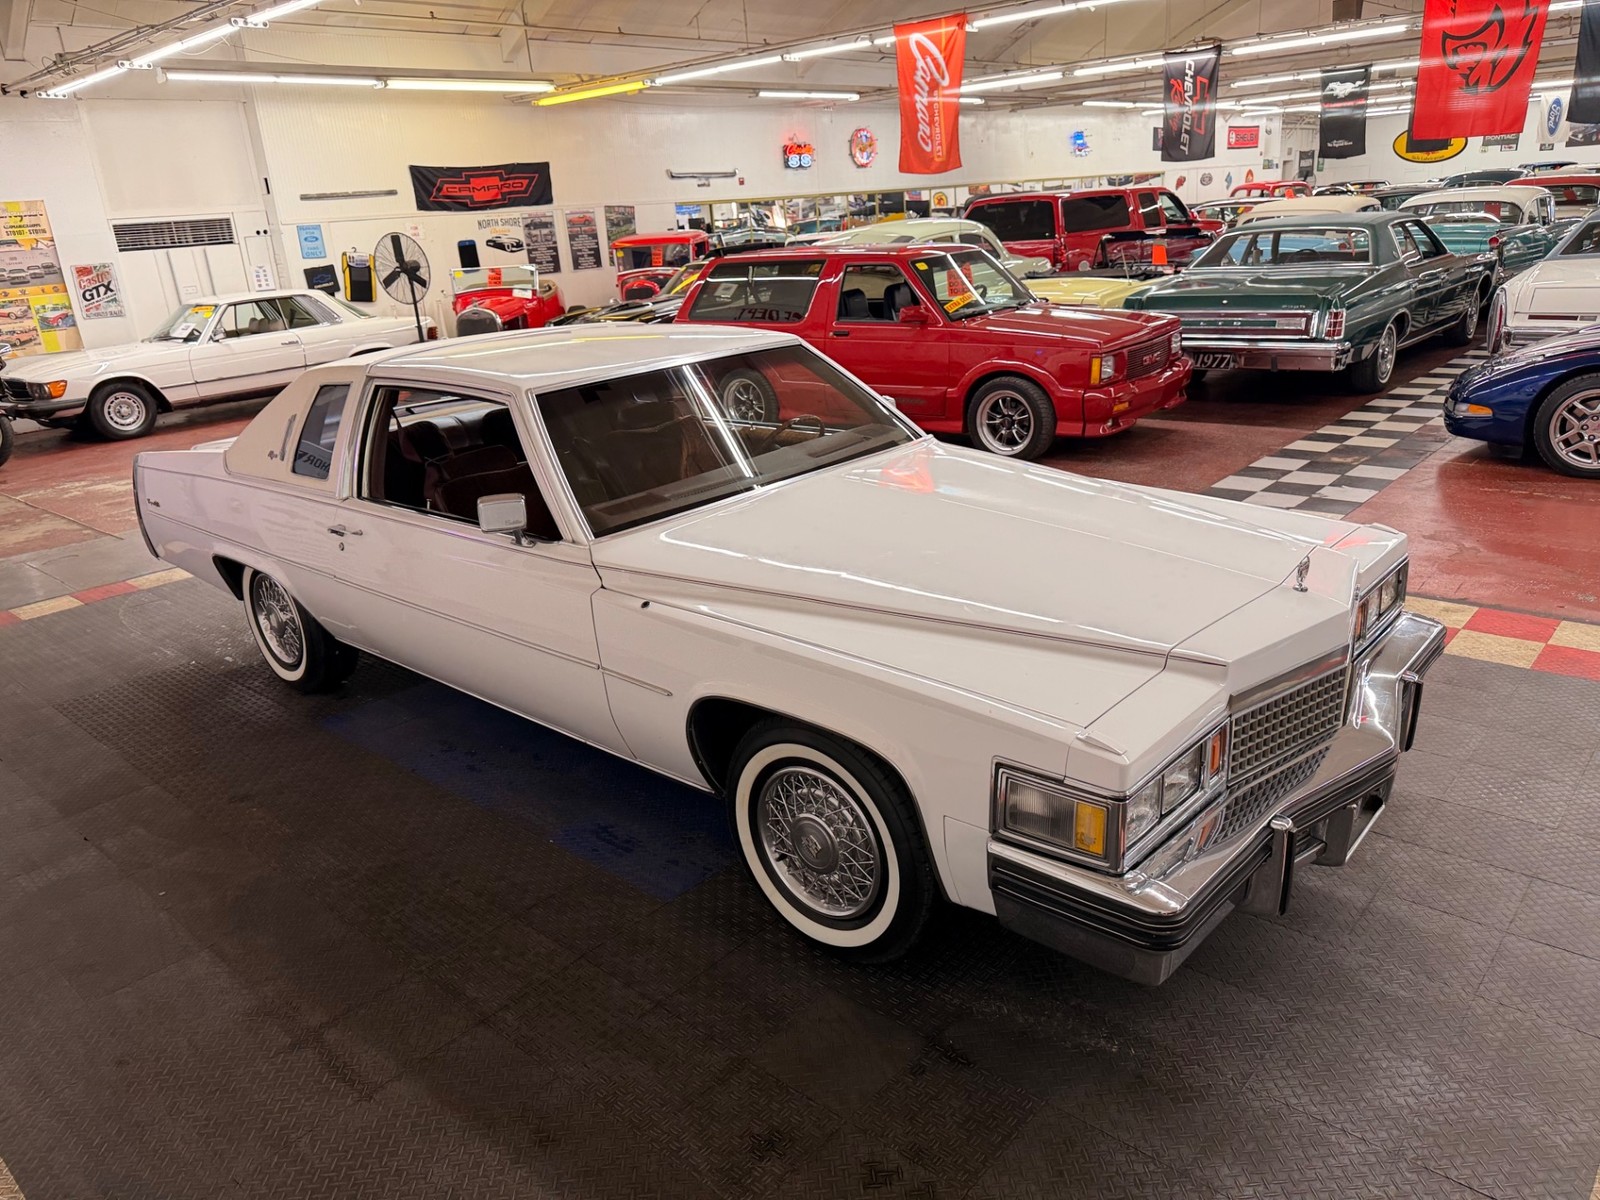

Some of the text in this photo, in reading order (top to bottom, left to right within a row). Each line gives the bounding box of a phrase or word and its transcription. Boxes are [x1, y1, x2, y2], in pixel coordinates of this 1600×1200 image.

[909, 33, 950, 153] Camaro
[1180, 59, 1195, 155] CHEVROLET
[1548, 104, 1560, 129] Ford
[933, 103, 942, 157] CHEVROLET
[1485, 133, 1516, 141] PONTIAC
[788, 154, 812, 168] SS
[446, 181, 524, 194] CAMARO
[477, 217, 522, 230] NORTH SHORE
[78, 270, 112, 290] Castro
[82, 280, 115, 302] GTX
[1142, 351, 1161, 365] GMC
[1196, 353, 1231, 369] 1977
